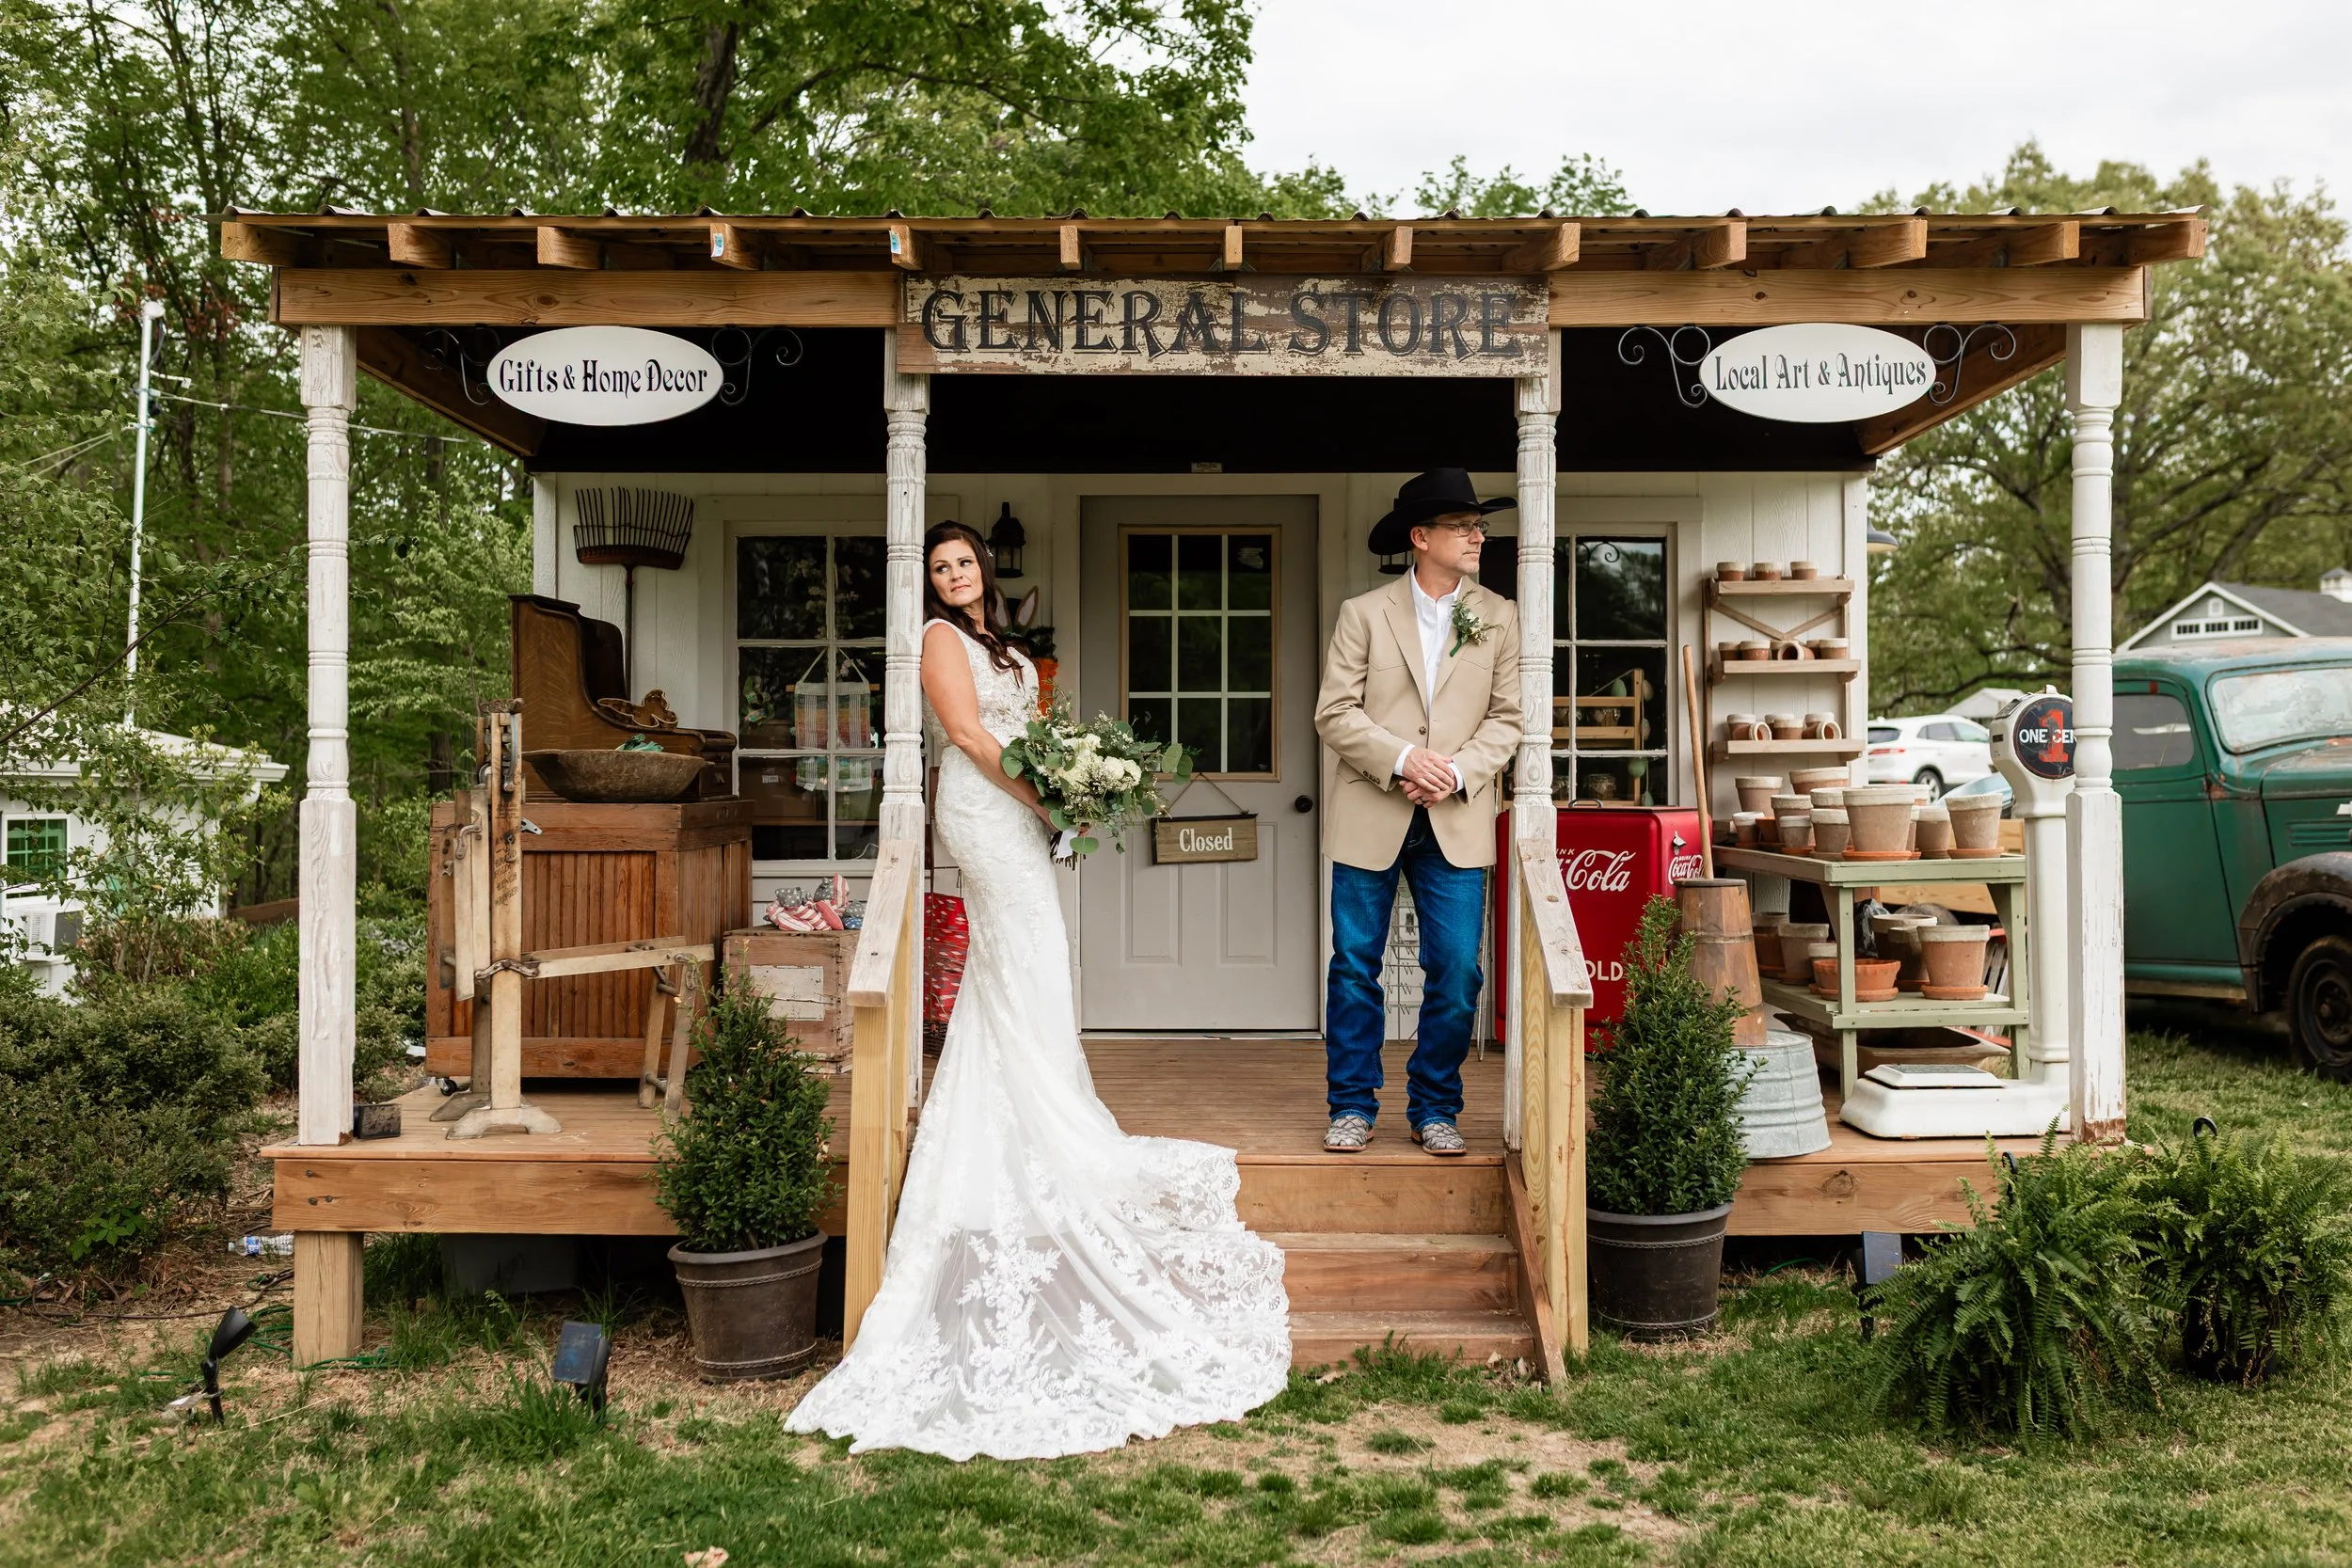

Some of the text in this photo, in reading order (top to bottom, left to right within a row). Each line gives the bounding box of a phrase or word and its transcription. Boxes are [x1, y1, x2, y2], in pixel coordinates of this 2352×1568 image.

[922, 289, 1524, 361] GENERAL STORE
[499, 358, 707, 399] Gifts & Home Decor
[1714, 353, 1927, 395] Local Art & Antiques
[2019, 729, 2077, 743] ONE CEN
[1179, 827, 1233, 852] Closed
[1584, 959, 1624, 981] OLD
